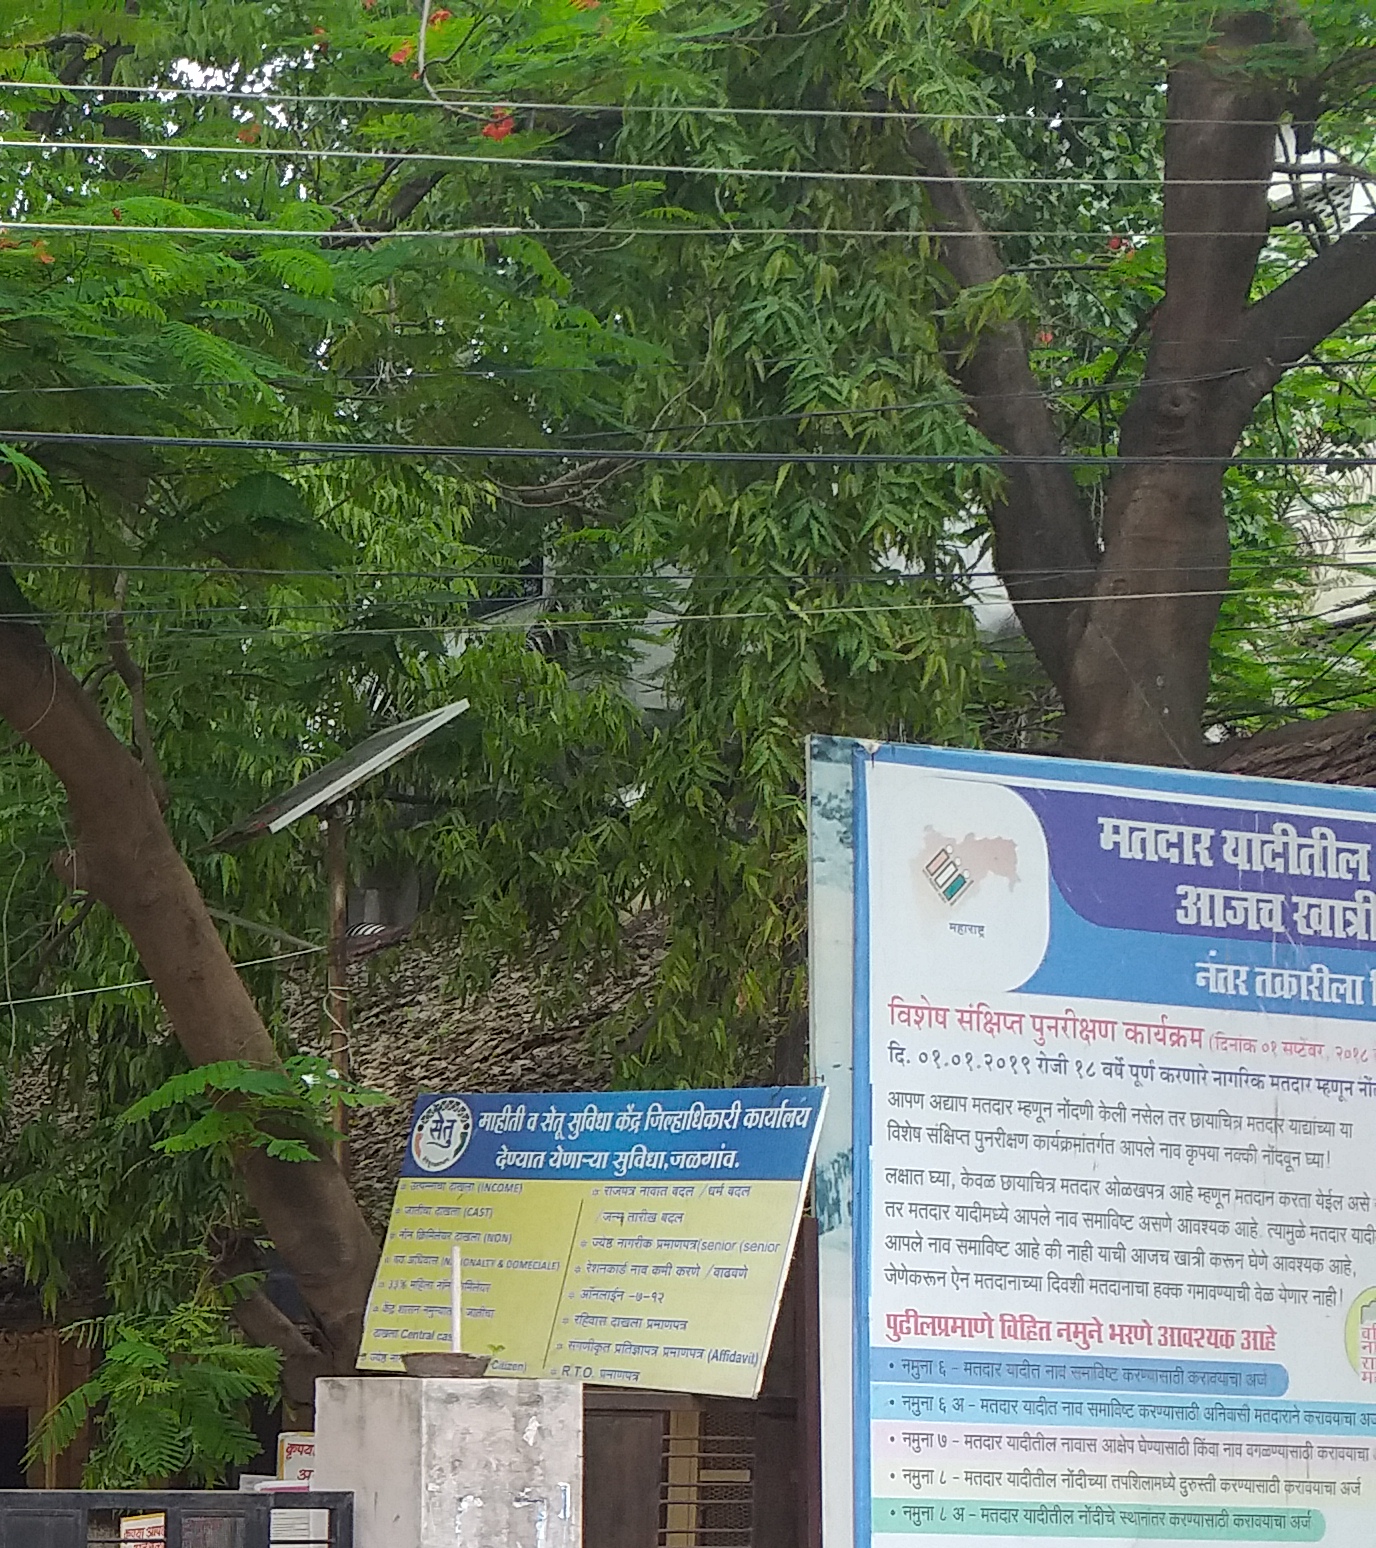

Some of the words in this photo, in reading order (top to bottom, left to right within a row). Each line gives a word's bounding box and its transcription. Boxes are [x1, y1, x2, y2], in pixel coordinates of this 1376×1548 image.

[1098, 817, 1214, 867] मतदार
[1221, 822, 1371, 882] यादीतील
[949, 923, 985, 938] महाराष्ट्र
[1176, 885, 1286, 933] आजच
[1291, 889, 1376, 941] खात्री
[1196, 949, 1250, 996] नंतर
[1255, 964, 1364, 1006] तक्रारीला
[888, 995, 950, 1030] विशेष
[955, 1003, 1025, 1038] संक्षिप्त
[1030, 1009, 1117, 1046] पुनरीक्षण
[1123, 1014, 1205, 1049] कार्यक्रम
[1262, 1040, 1278, 1058] ०१
[888, 1041, 910, 1067] दि.
[1036, 1051, 1069, 1075] रोजी
[1075, 1060, 1096, 1079] १८
[1101, 1056, 1125, 1080] वर्षे
[1129, 1059, 1155, 1087] पूर्ण
[1159, 1063, 1208, 1085] करणारे
[1211, 1067, 1265, 1090] नागरिक
[1269, 1075, 1313, 1093] मतदार
[1316, 1079, 1354, 1102] म्हणून
[478, 1106, 525, 1133] माहीती
[528, 1111, 536, 1130] व
[567, 1106, 613, 1141] सुविधा
[616, 1104, 641, 1134] केंद्र
[646, 1103, 741, 1134] जिल्हाधिकारी
[743, 1100, 812, 1130] कार्यालय
[888, 1091, 925, 1109] आपण
[930, 1095, 968, 1112] अद्याप
[972, 1097, 1013, 1115] मतदार
[1017, 1100, 1053, 1123] म्हणून
[1057, 1097, 1094, 1121] नोंदणी
[1098, 1100, 1127, 1123] केली
[1131, 1103, 1164, 1126] नसेल
[1168, 1111, 1186, 1126] तर
[1190, 1109, 1243, 1130] छायाचित्र
[1247, 1117, 1285, 1134] मतदार
[1339, 1123, 1353, 1139] या
[495, 1146, 546, 1170] देण्यात
[478, 1183, 523, 1194] (INCOME)
[464, 1207, 493, 1219] (CAST)
[484, 1233, 512, 1245] (NON)
[630, 1265, 647, 1276] नाव
[400, 1329, 435, 1340] Central
[886, 1309, 994, 1343] पुढीलप्रमाणे
[999, 1314, 1051, 1341] विहित
[1057, 1312, 1103, 1350] नमुने
[1109, 1319, 1153, 1347] भरणे
[1158, 1325, 1236, 1349] आवश्यक
[1241, 1325, 1277, 1351] आहे
